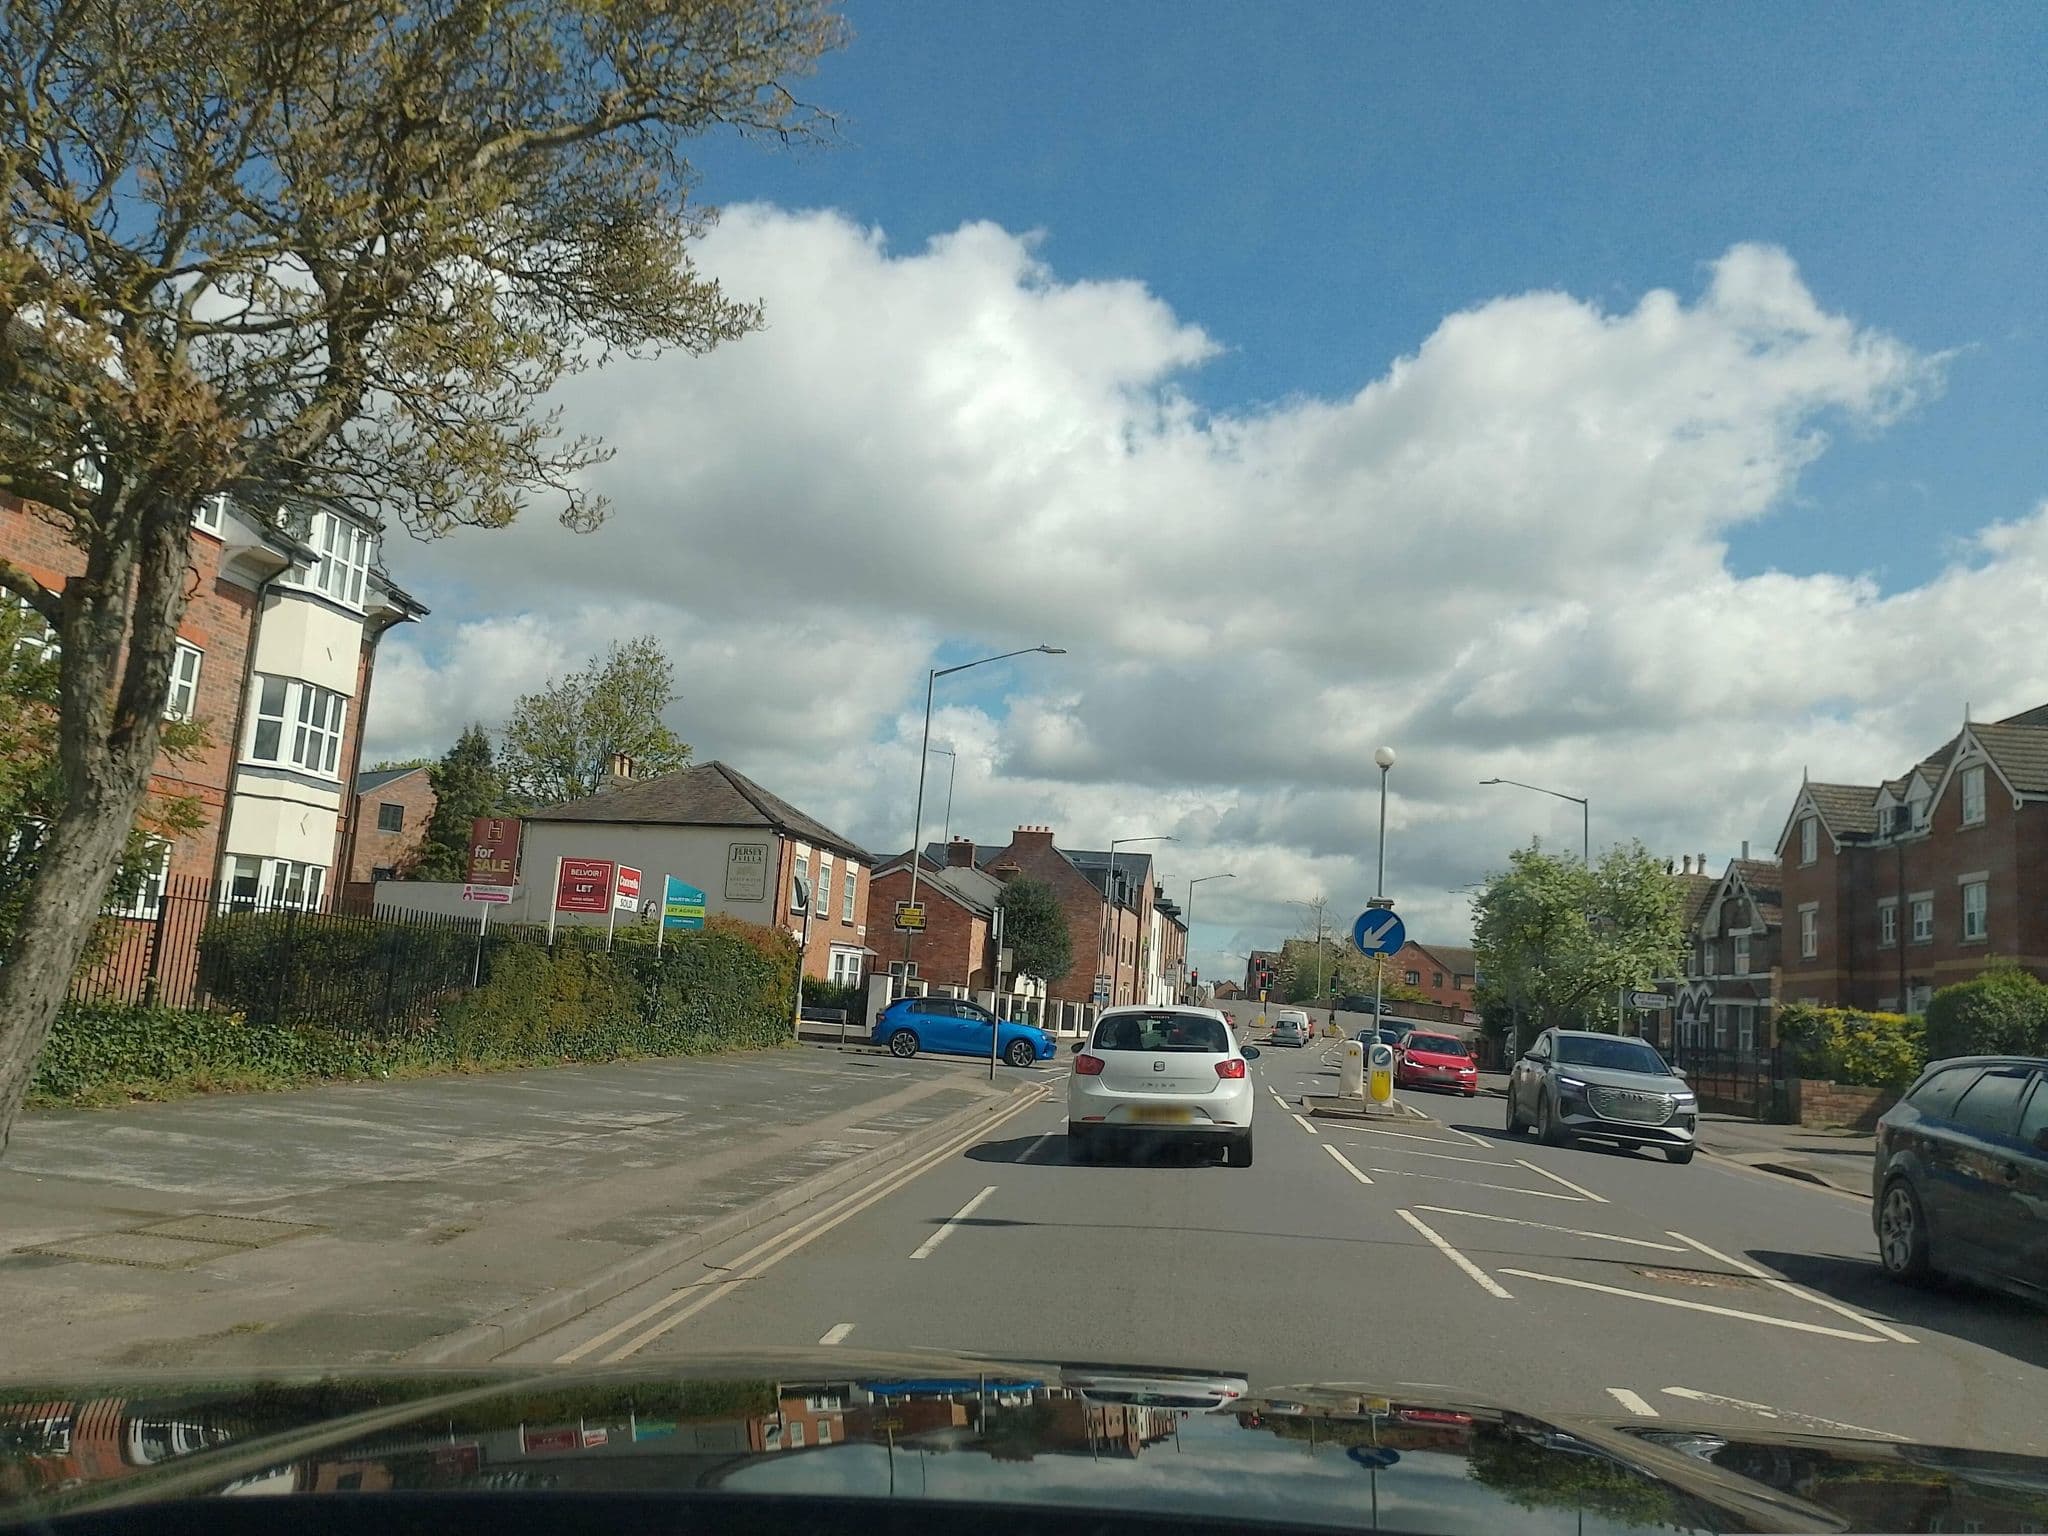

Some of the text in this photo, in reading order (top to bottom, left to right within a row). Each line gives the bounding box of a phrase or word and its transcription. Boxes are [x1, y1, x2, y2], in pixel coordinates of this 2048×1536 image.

[474, 845, 494, 858] for
[472, 859, 510, 873] SALE
[576, 884, 593, 893] LET
[620, 898, 633, 908] SOLD
